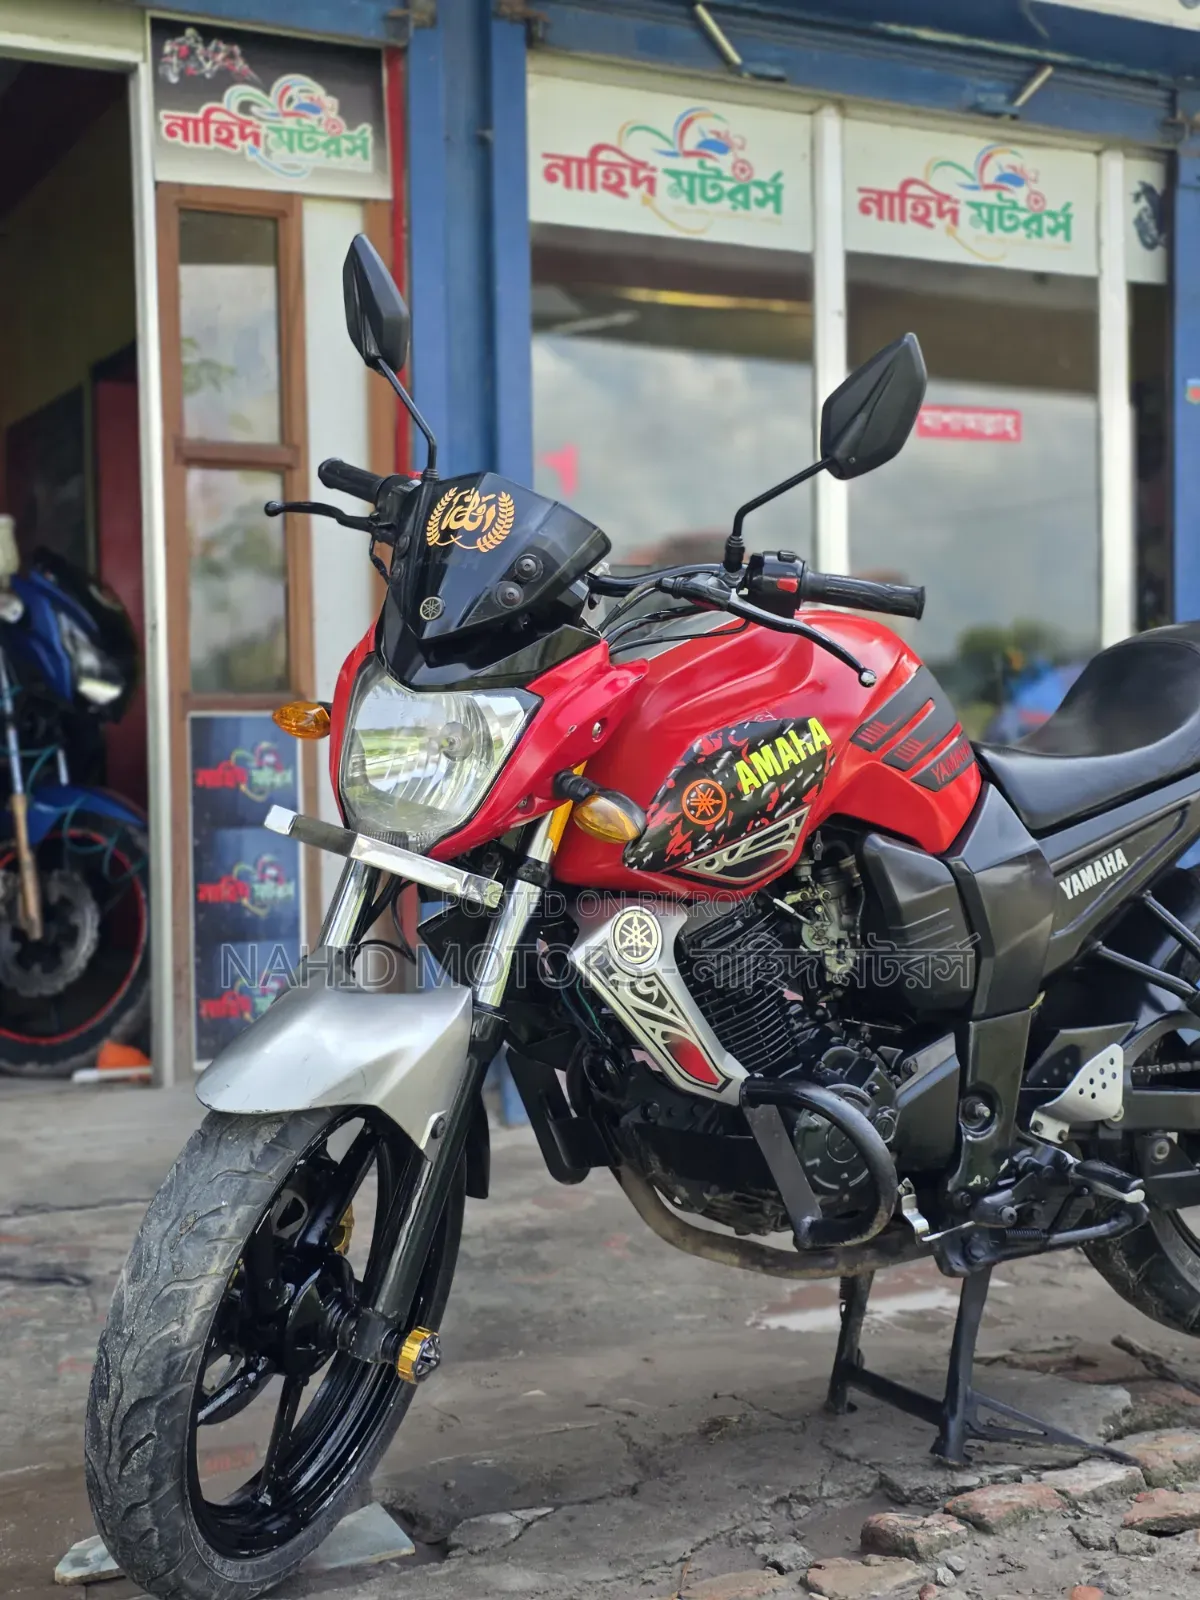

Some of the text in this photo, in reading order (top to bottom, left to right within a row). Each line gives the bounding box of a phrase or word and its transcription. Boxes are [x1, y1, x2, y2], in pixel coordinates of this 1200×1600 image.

[160, 104, 262, 150] নাহিদ
[541, 142, 658, 199] নাহিদ
[857, 176, 961, 230] নাহিদ
[1059, 848, 1129, 900] YAMAHA
